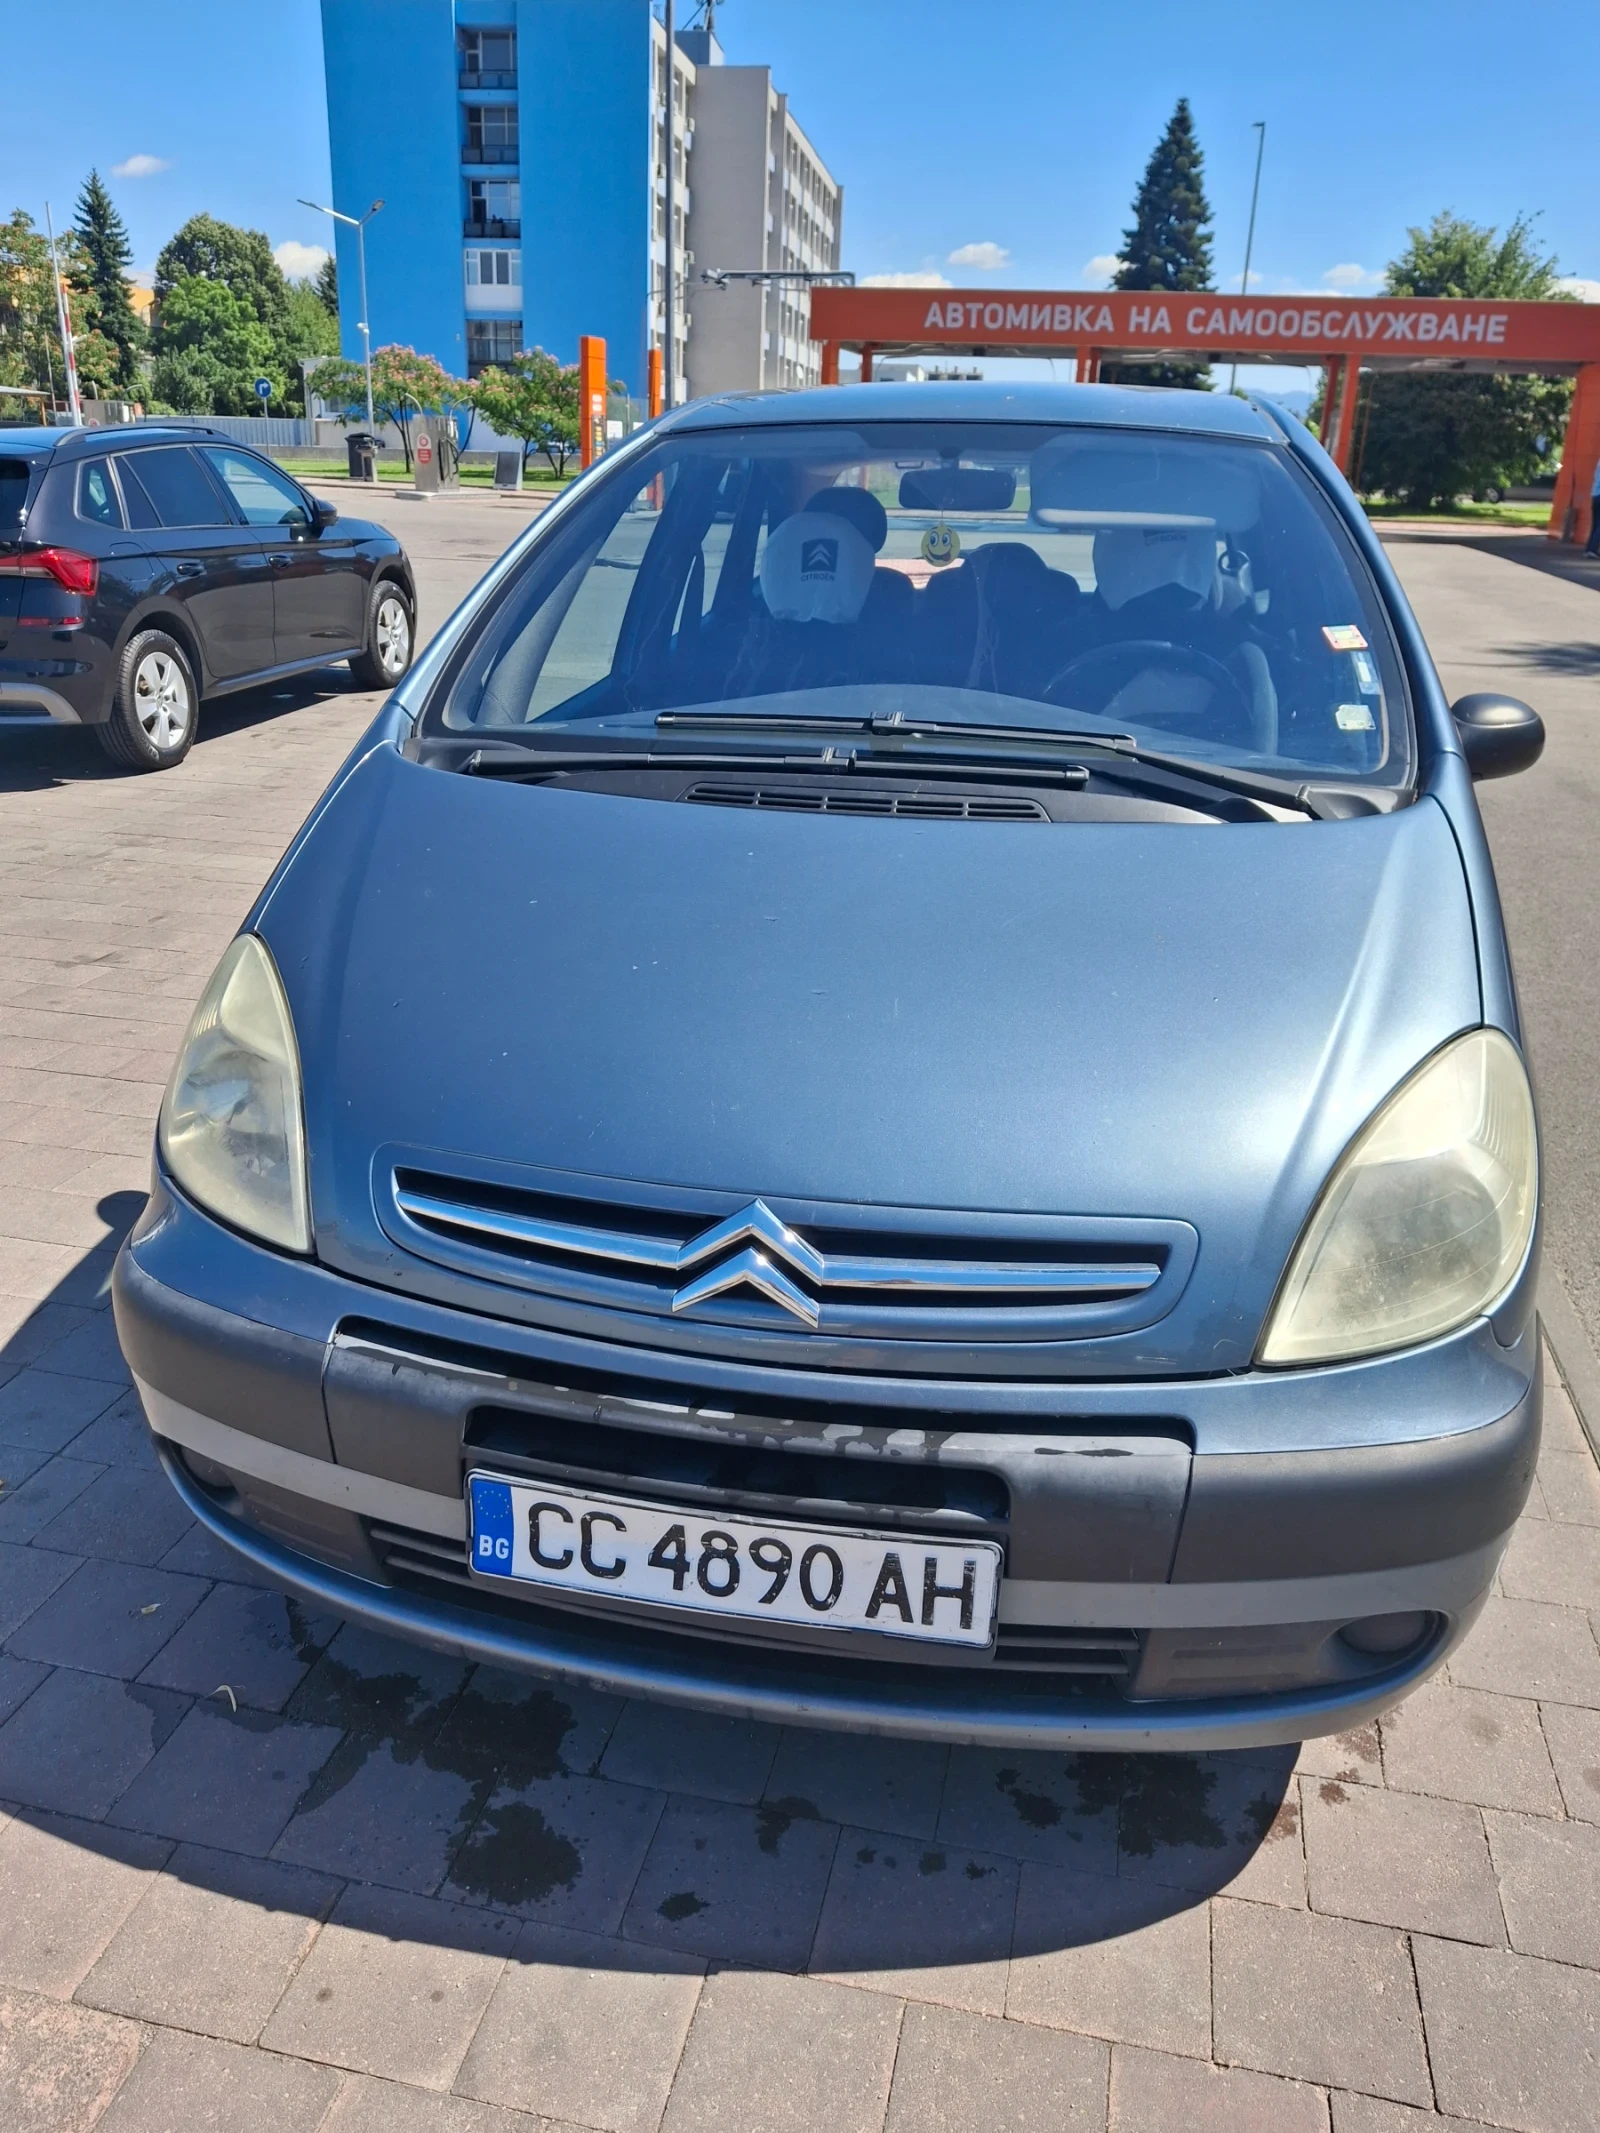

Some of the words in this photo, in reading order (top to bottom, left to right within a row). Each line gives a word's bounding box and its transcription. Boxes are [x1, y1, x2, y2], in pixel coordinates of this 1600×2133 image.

[924, 301, 1114, 333] АВТОМИВКА
[1128, 305, 1172, 334] НА
[1186, 306, 1508, 343] САМООБСЛУЖВАНЕ
[479, 1534, 509, 1560] BG
[527, 1501, 627, 1580] CC
[647, 1524, 844, 1612] 4890
[864, 1552, 977, 1630] AH
